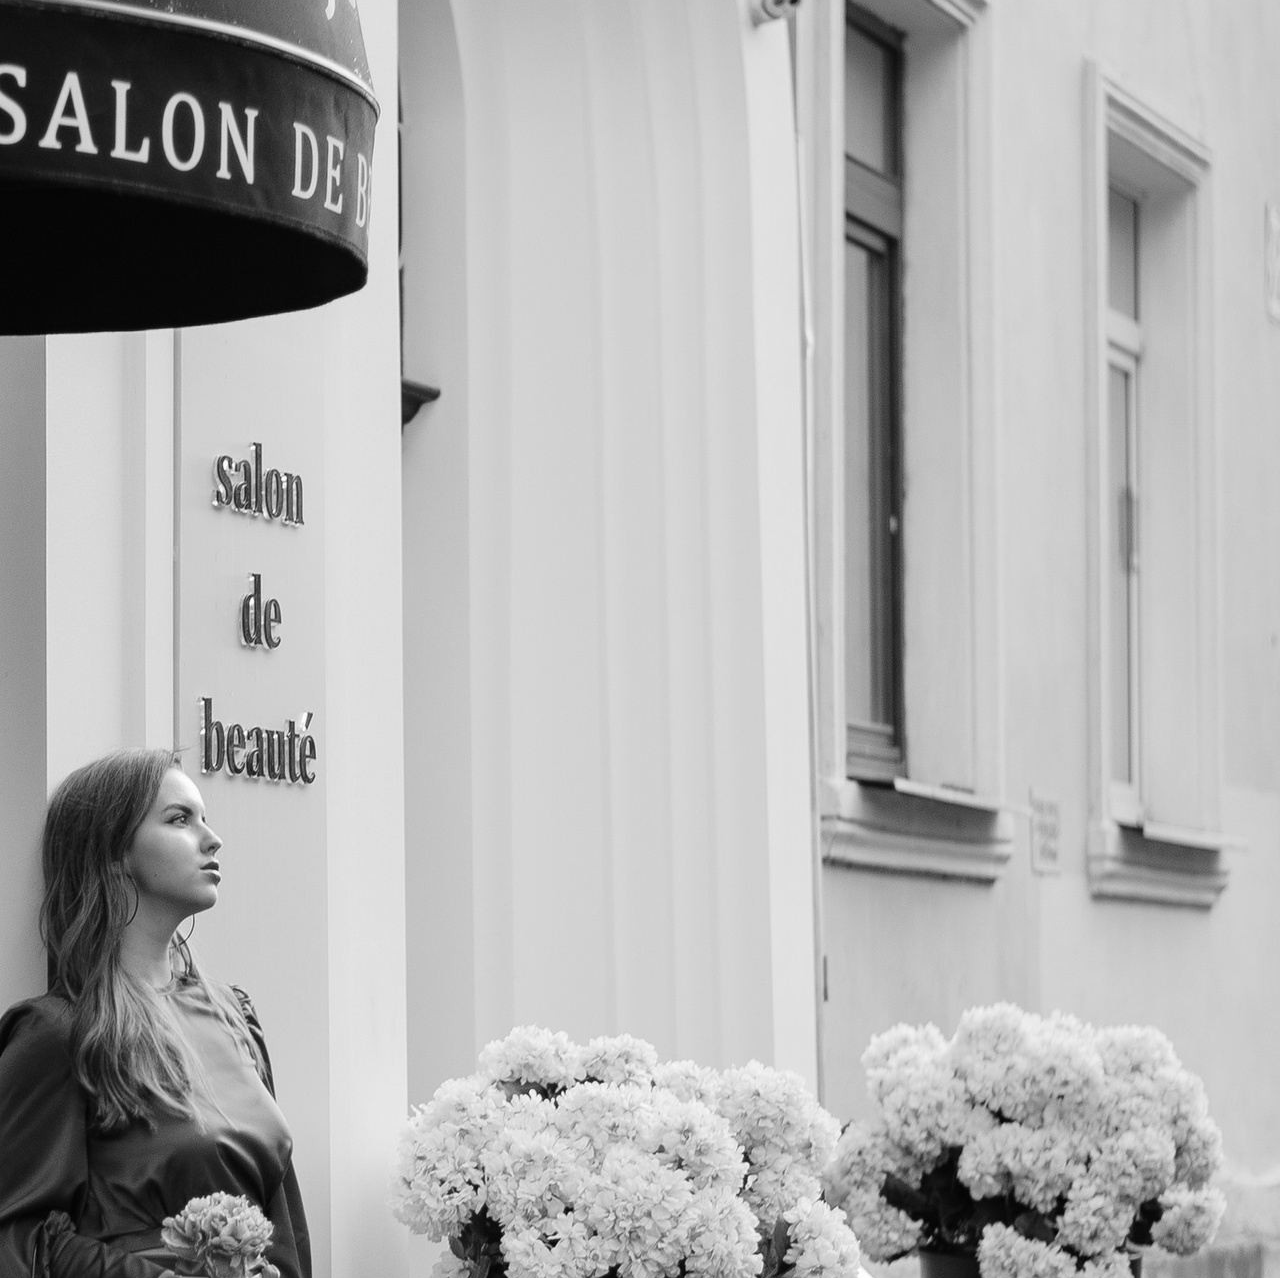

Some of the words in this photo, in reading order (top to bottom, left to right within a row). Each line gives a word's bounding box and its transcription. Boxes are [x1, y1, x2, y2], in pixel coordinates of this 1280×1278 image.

[291, 121, 344, 215] DE
[212, 442, 304, 526] salon
[239, 573, 282, 650] de
[197, 697, 317, 785] beauté
